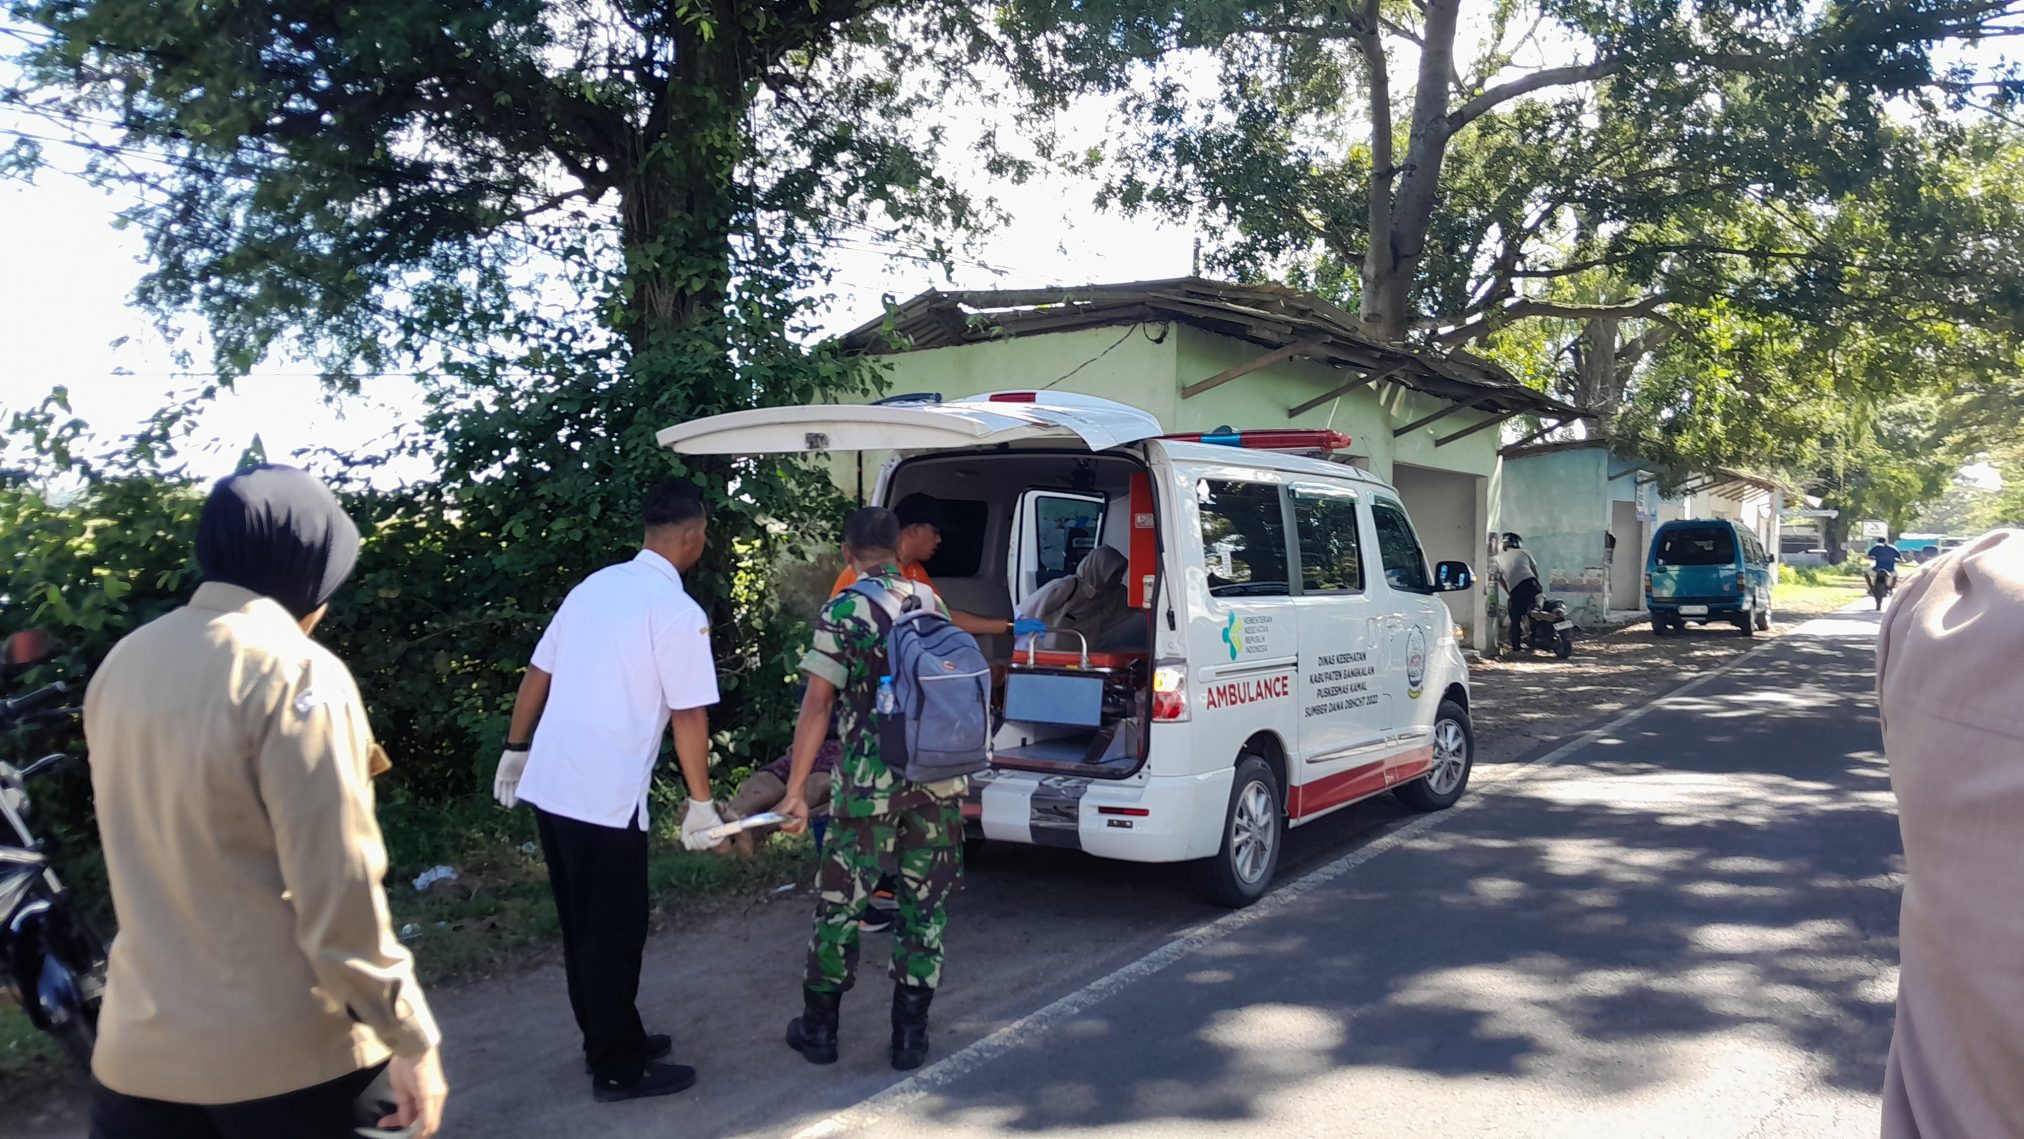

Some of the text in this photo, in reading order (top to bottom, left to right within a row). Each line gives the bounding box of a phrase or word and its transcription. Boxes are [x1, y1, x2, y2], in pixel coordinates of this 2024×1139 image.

[1318, 652, 1367, 667] DINAS KESEHATAN
[1309, 665, 1375, 685] KABUPATEN BANGKALAN
[1206, 675, 1289, 710] AMBULANCE
[1317, 681, 1367, 699] PUSKESMAS KAMAL
[1305, 703, 1328, 718] SUMBER
[1328, 701, 1344, 713] DANA
